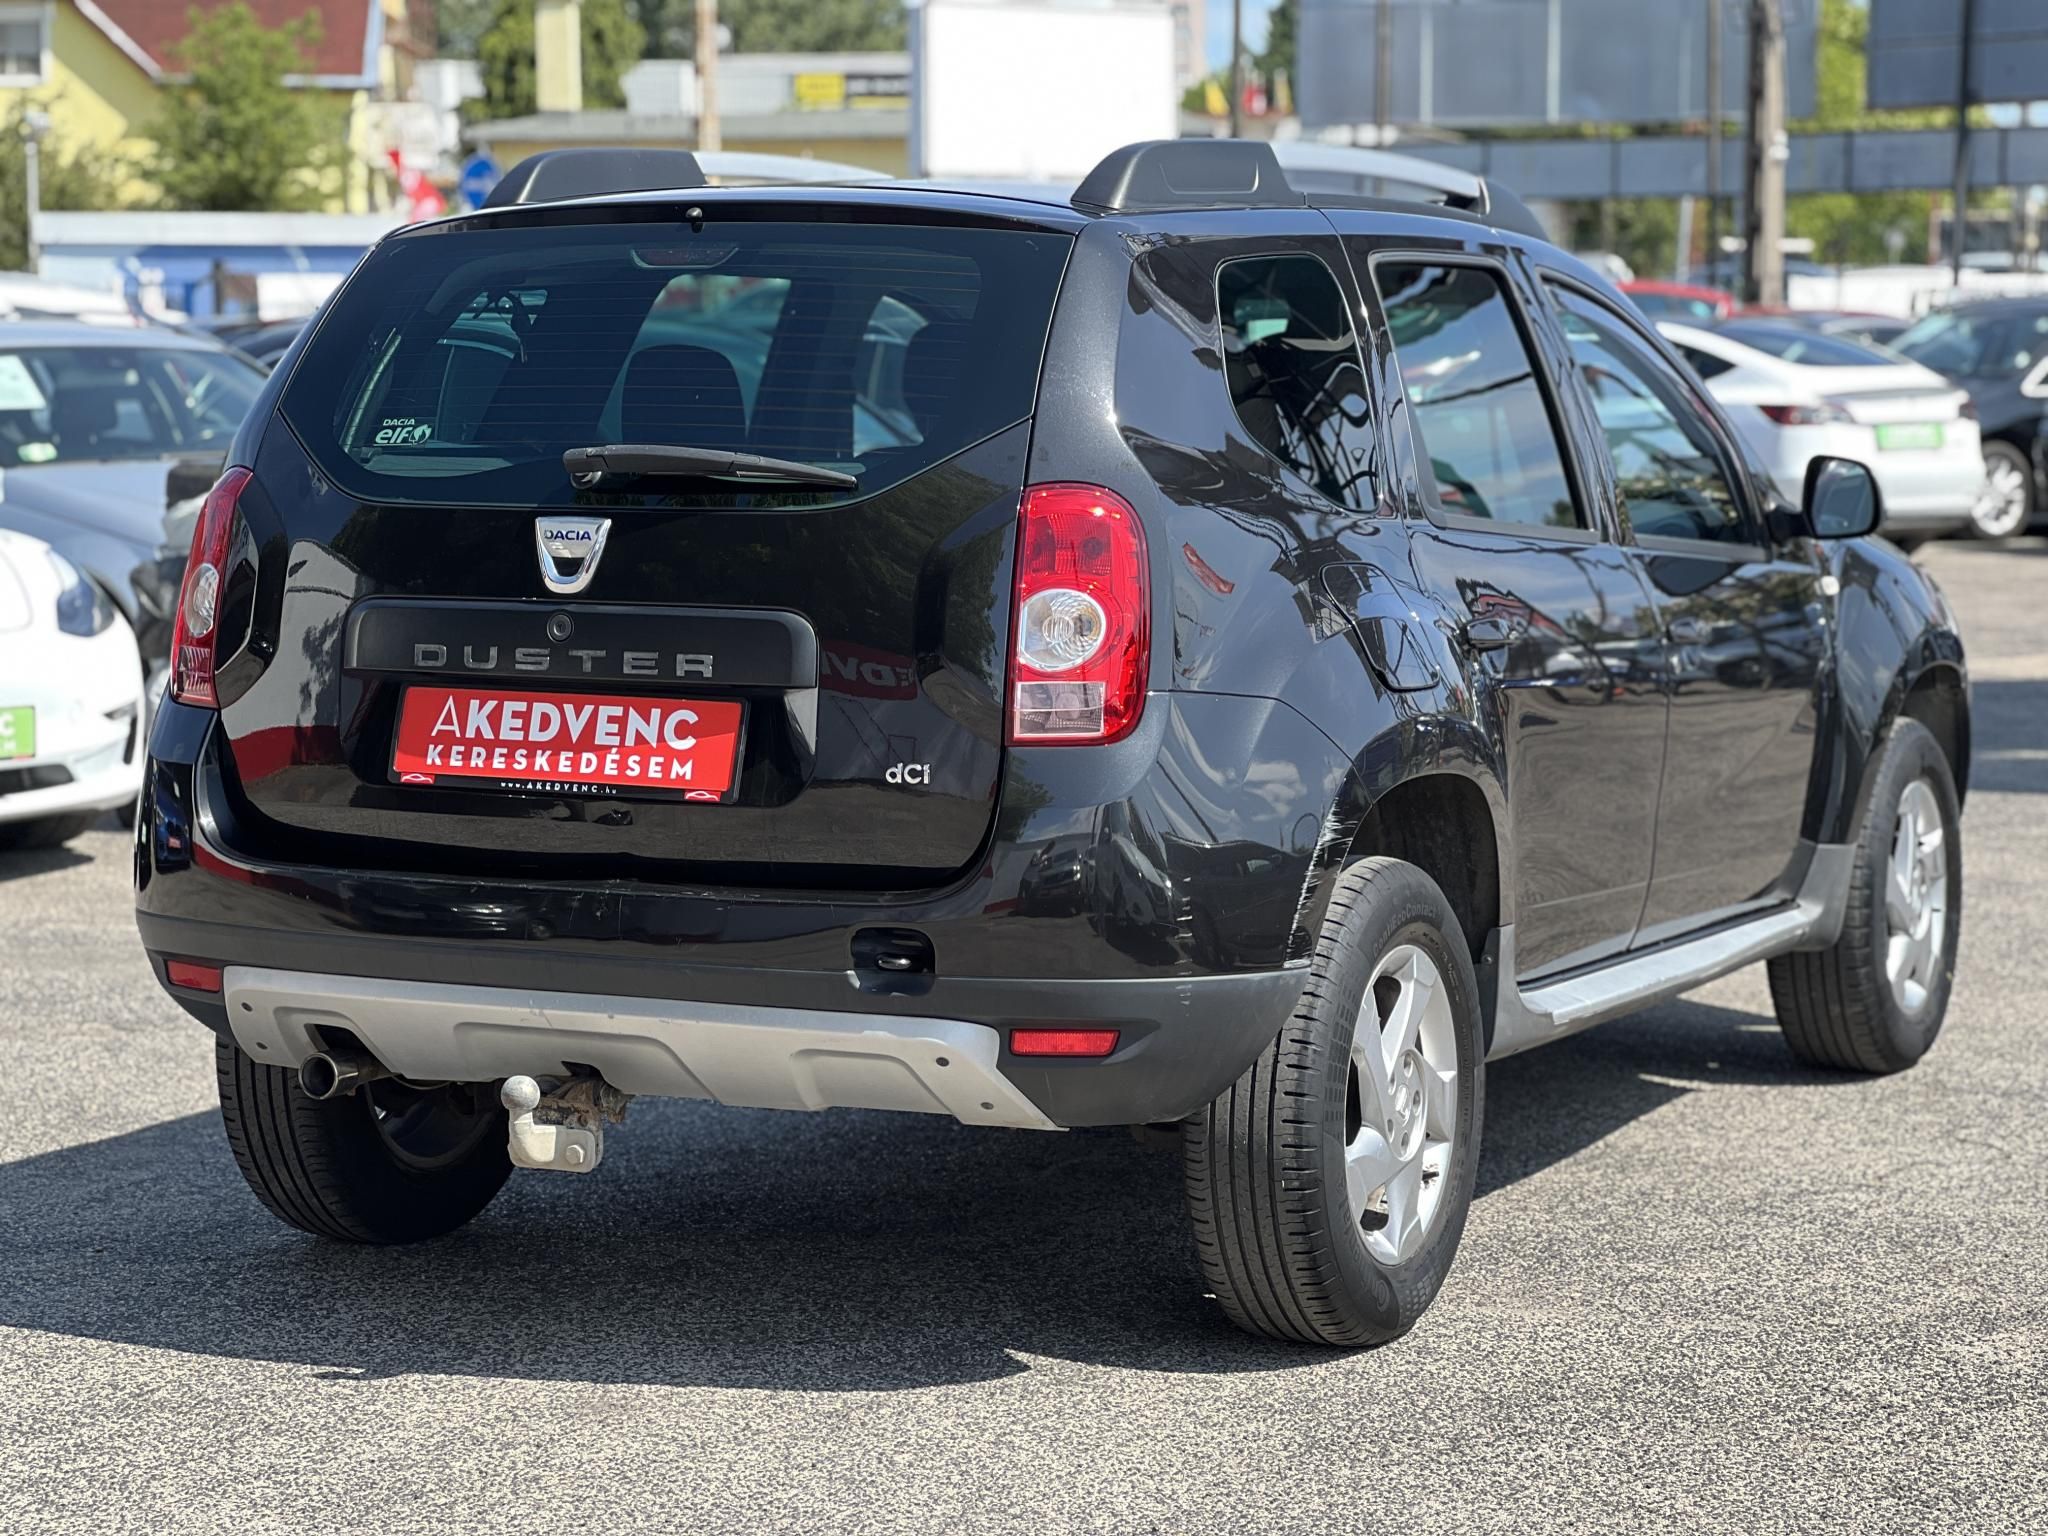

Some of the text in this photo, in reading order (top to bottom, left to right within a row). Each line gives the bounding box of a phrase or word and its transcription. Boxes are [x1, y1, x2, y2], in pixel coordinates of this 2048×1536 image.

[382, 418, 415, 426] DACIA
[375, 426, 413, 444] elf
[544, 529, 592, 541] DACIA
[414, 643, 714, 678] DUSTER
[431, 695, 700, 750] AKEDVENC
[426, 743, 695, 781] KERESKEDÉSEM
[885, 762, 930, 784] dCi
[500, 781, 617, 794] www.AKEDVENC.hu
